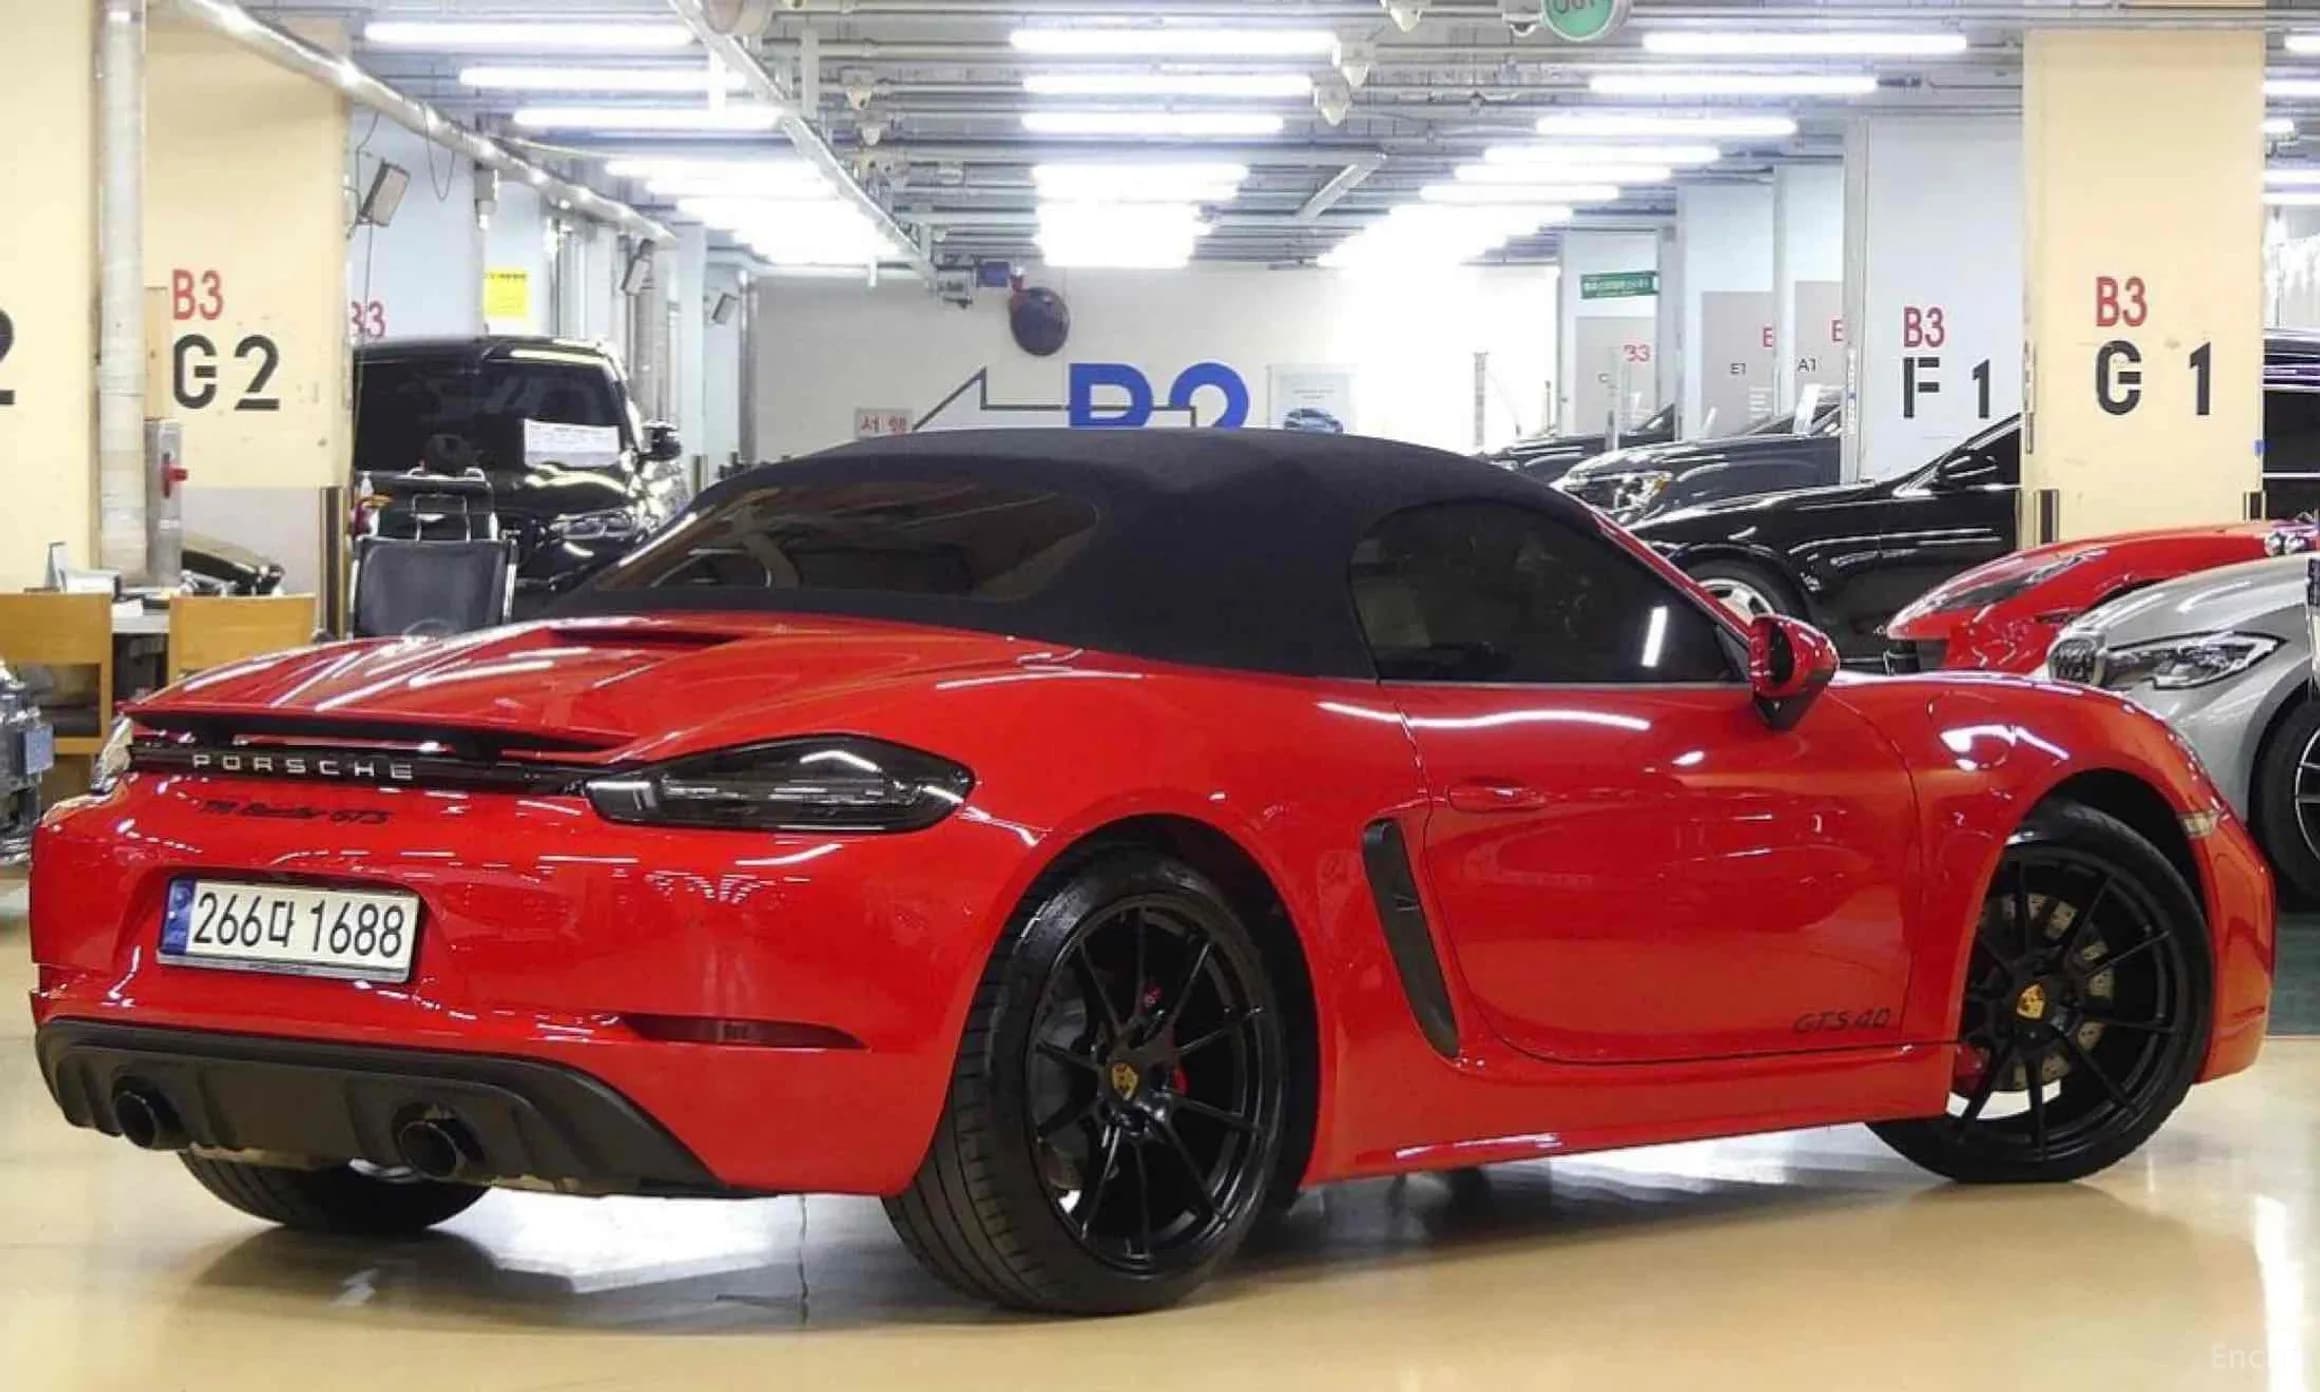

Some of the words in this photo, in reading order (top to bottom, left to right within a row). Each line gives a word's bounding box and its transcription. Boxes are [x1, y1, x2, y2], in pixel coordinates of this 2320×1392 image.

[172, 269, 224, 320] B3
[2096, 276, 2148, 327] B3
[1903, 306, 1945, 348] B3
[1903, 357, 1940, 419] F
[1972, 359, 1990, 419] 1
[2096, 339, 2142, 416] G
[2189, 341, 2211, 416] 1
[192, 754, 413, 780] PORSCHE
[193, 891, 296, 948] 266다
[310, 899, 405, 959] 1688
